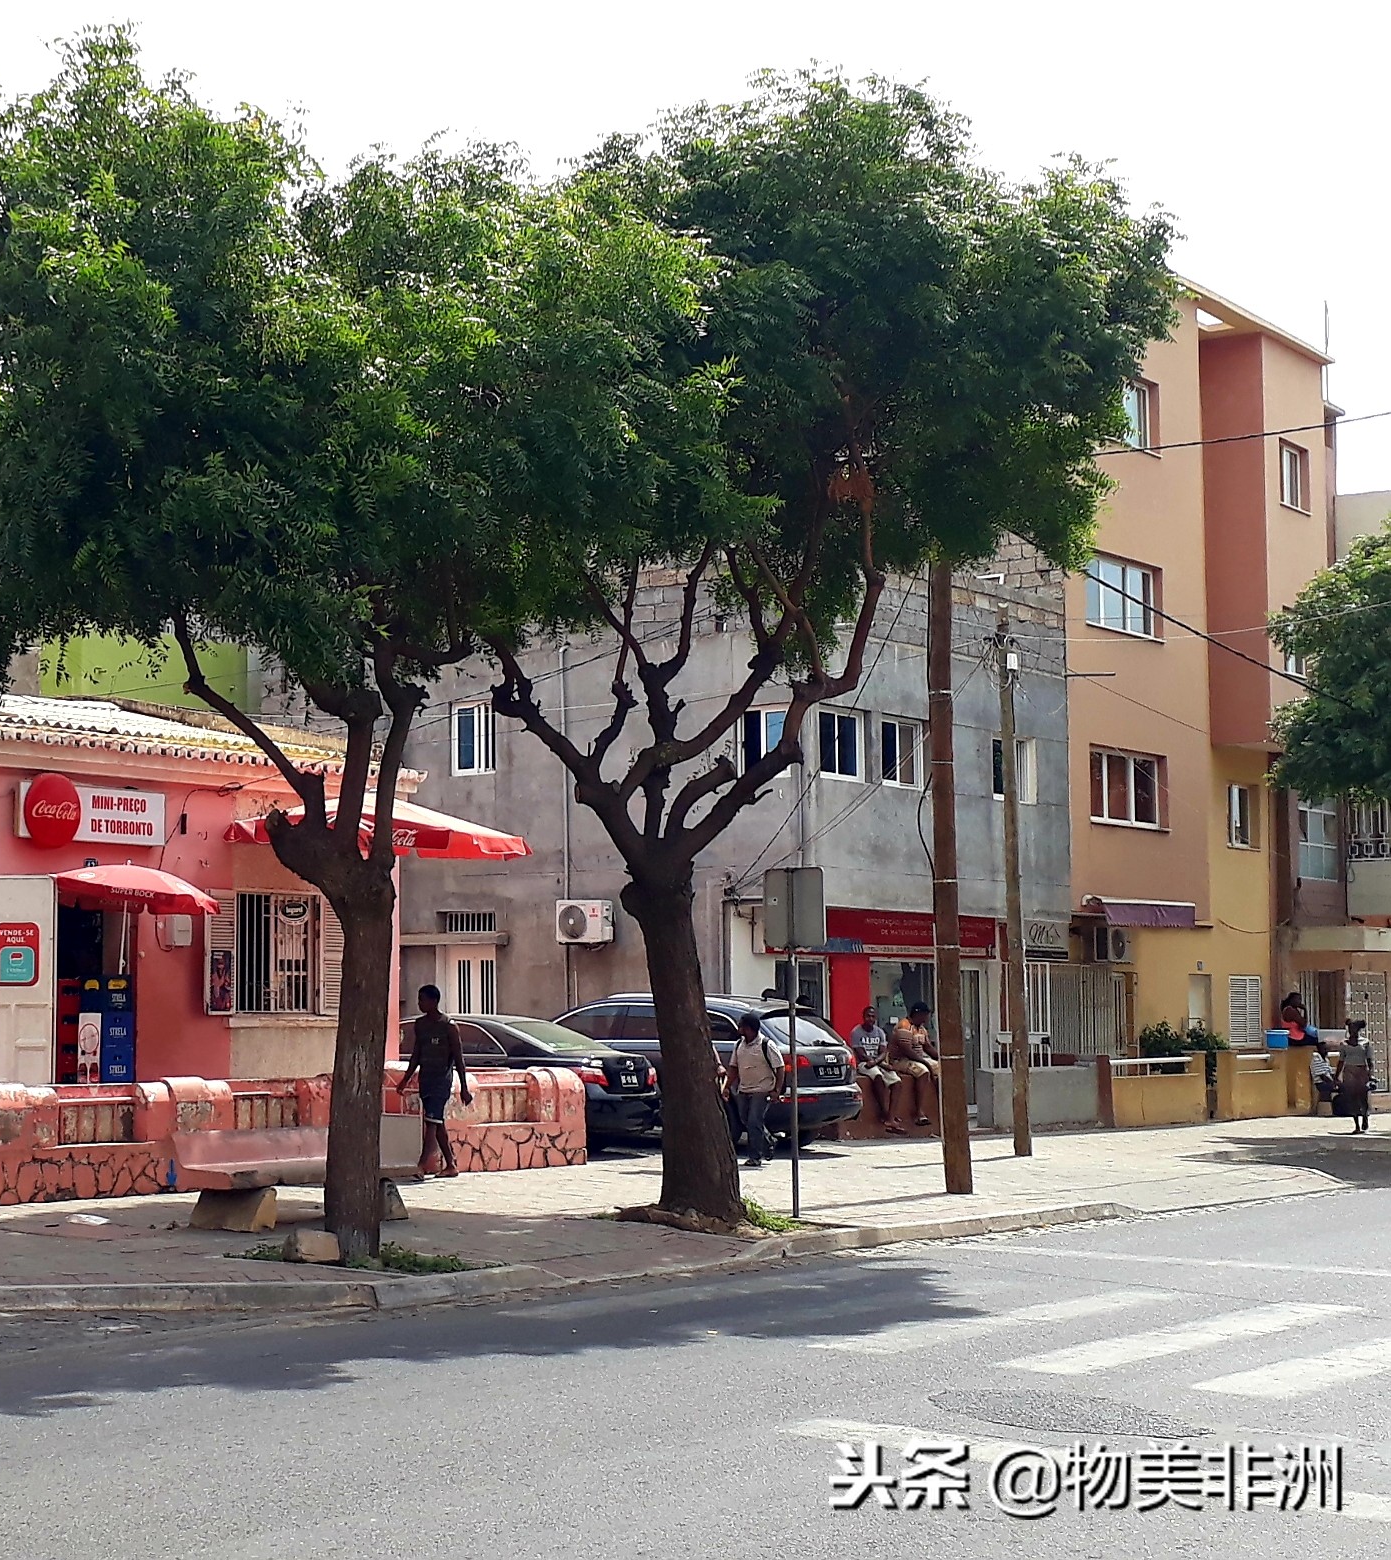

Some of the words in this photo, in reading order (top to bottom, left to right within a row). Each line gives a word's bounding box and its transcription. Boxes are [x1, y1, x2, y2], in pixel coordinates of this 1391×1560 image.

[91, 794, 147, 816] MINI-PREÇO
[90, 818, 103, 833] DE
[104, 819, 154, 837] TORRONTO
[110, 886, 133, 896] SUPER
[134, 888, 156, 899] BOCK
[109, 1027, 127, 1036] STRELA
[109, 1065, 127, 1075] STRELA
